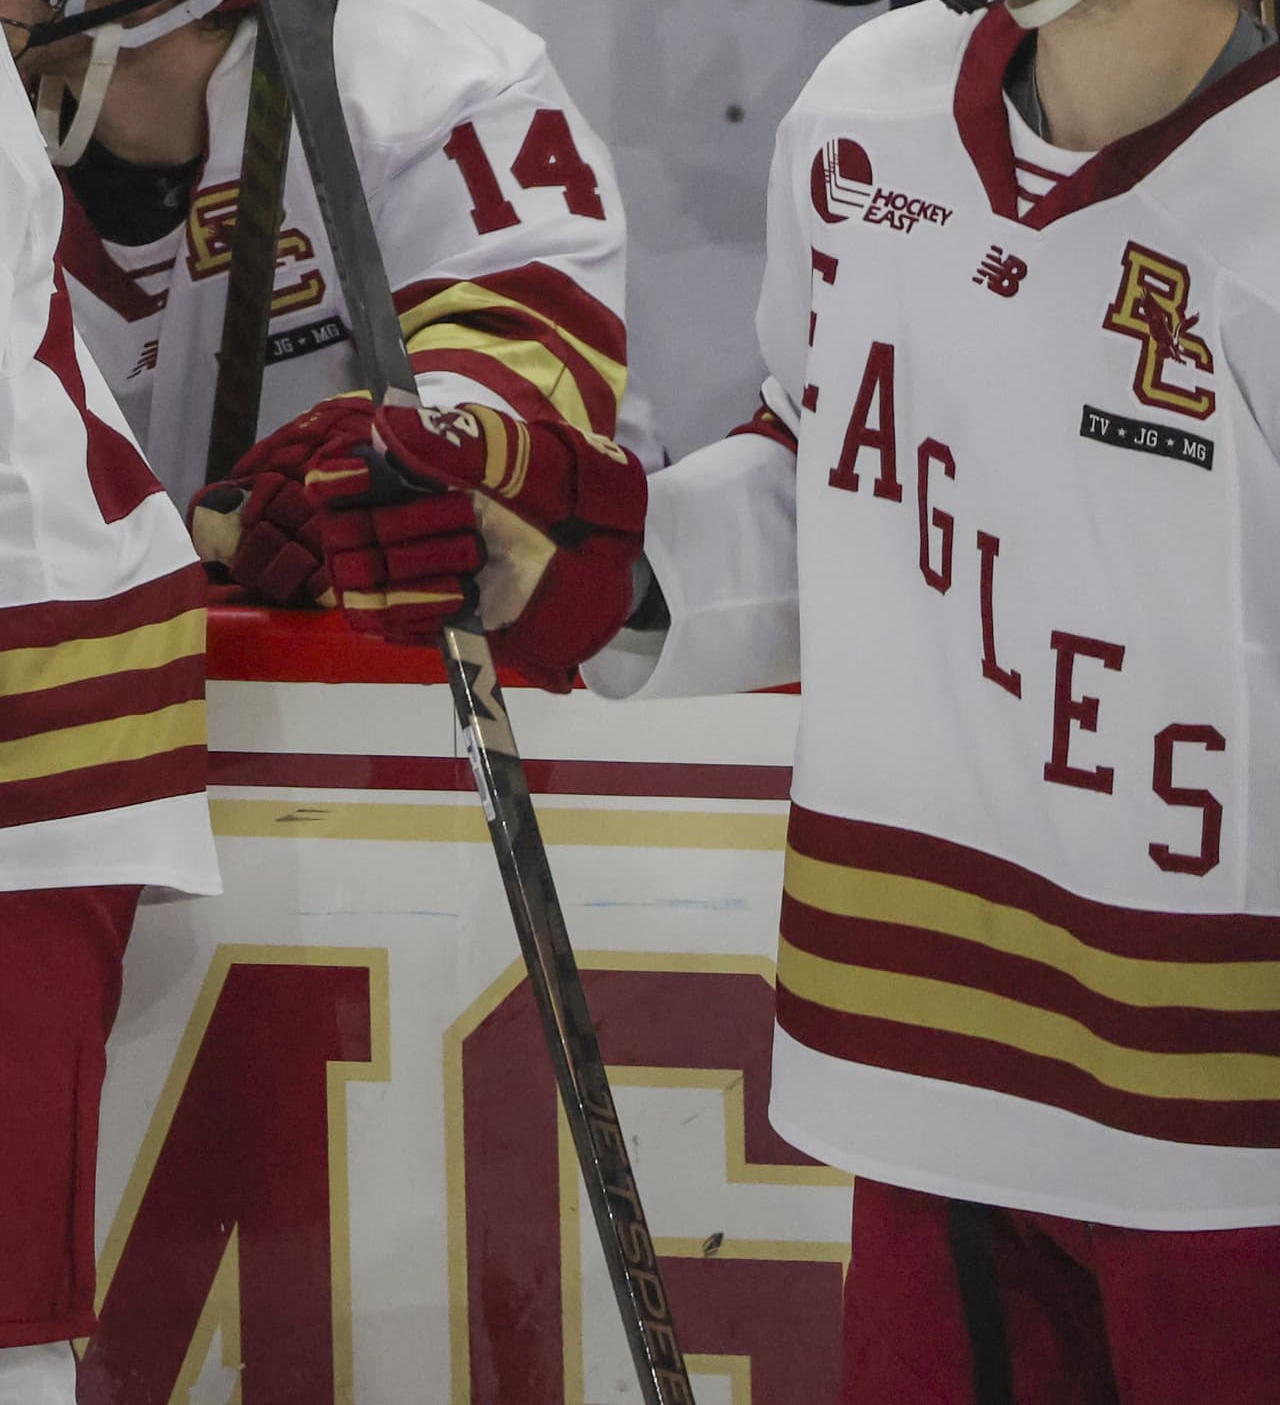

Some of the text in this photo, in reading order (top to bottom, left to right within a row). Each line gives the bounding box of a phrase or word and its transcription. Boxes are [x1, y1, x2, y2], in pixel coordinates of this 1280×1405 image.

[443, 108, 607, 236] 14
[862, 204, 920, 235] EAST
[872, 187, 954, 227] HOCKEY
[1089, 413, 1207, 462] TV JG MG
